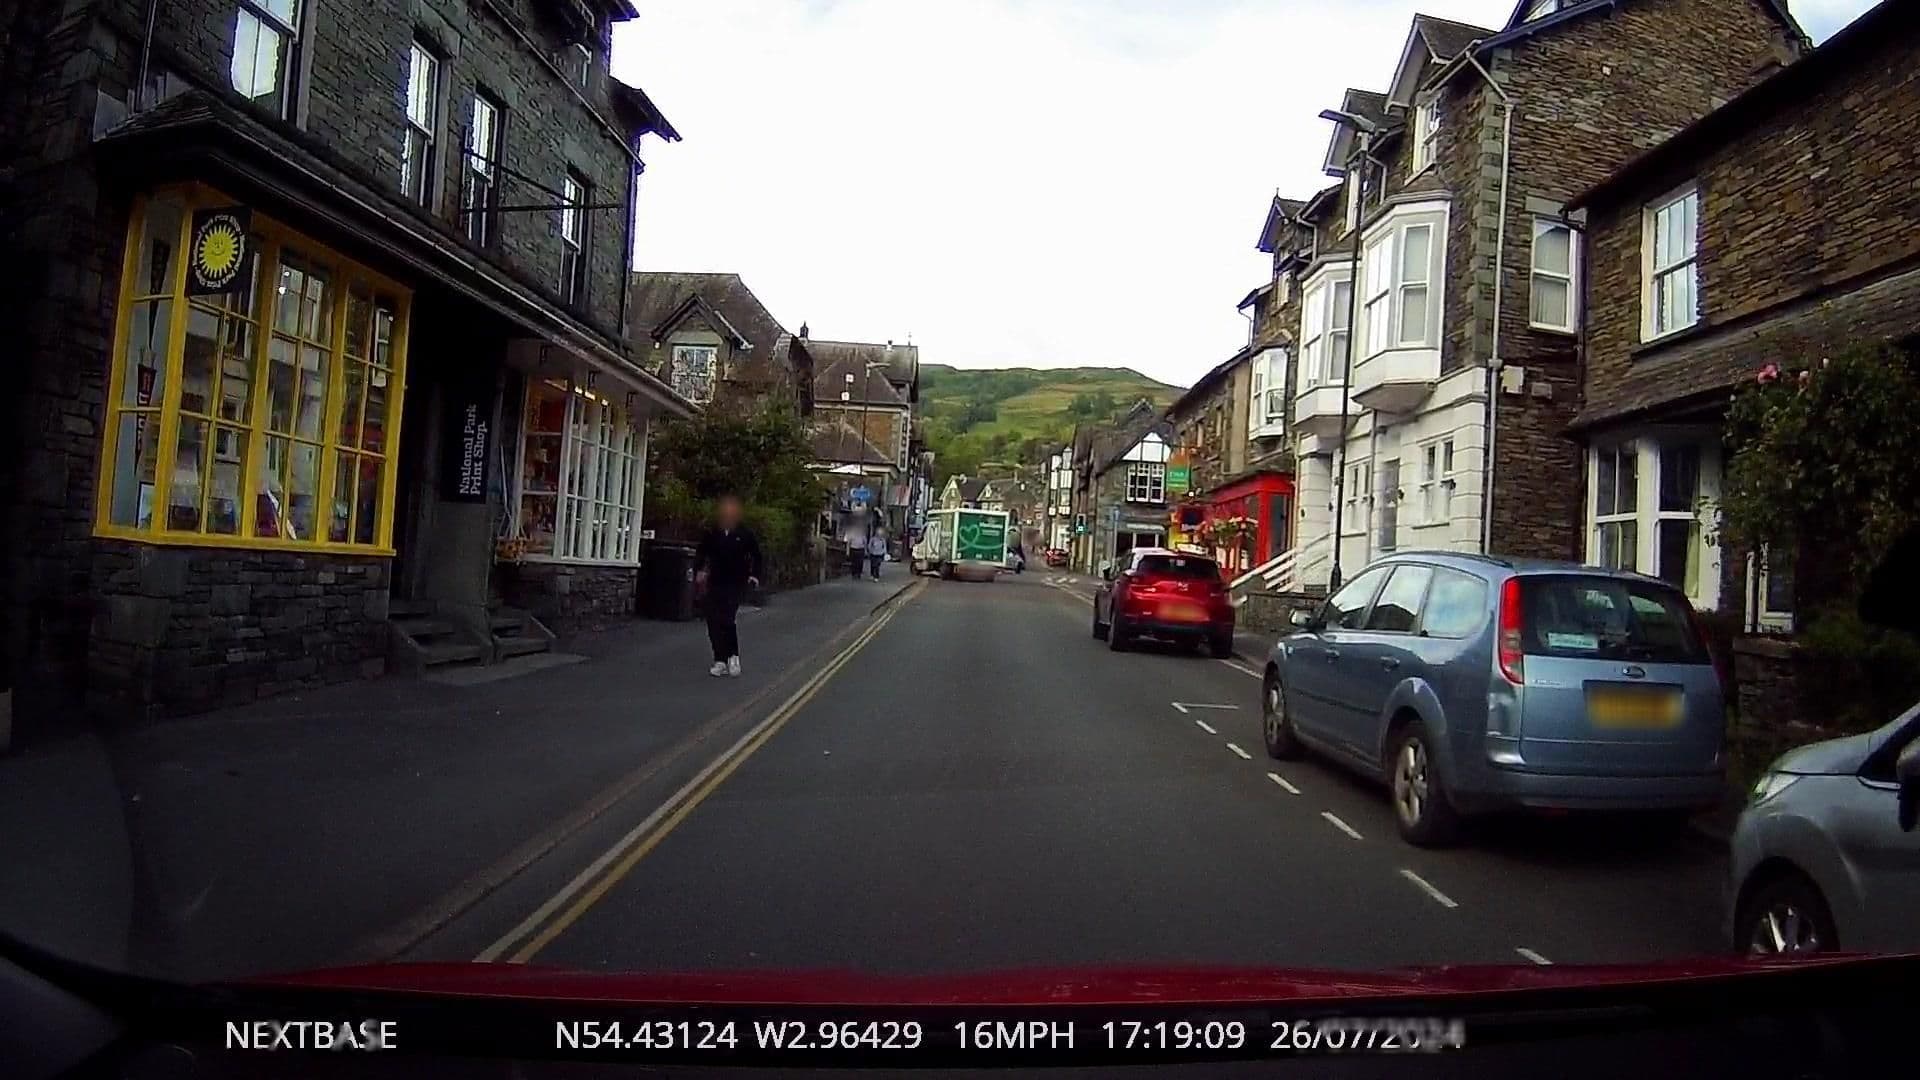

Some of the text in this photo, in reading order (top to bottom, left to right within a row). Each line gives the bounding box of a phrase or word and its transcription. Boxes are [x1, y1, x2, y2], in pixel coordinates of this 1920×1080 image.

[459, 403, 477, 494] National Park
[470, 461, 482, 495] Print
